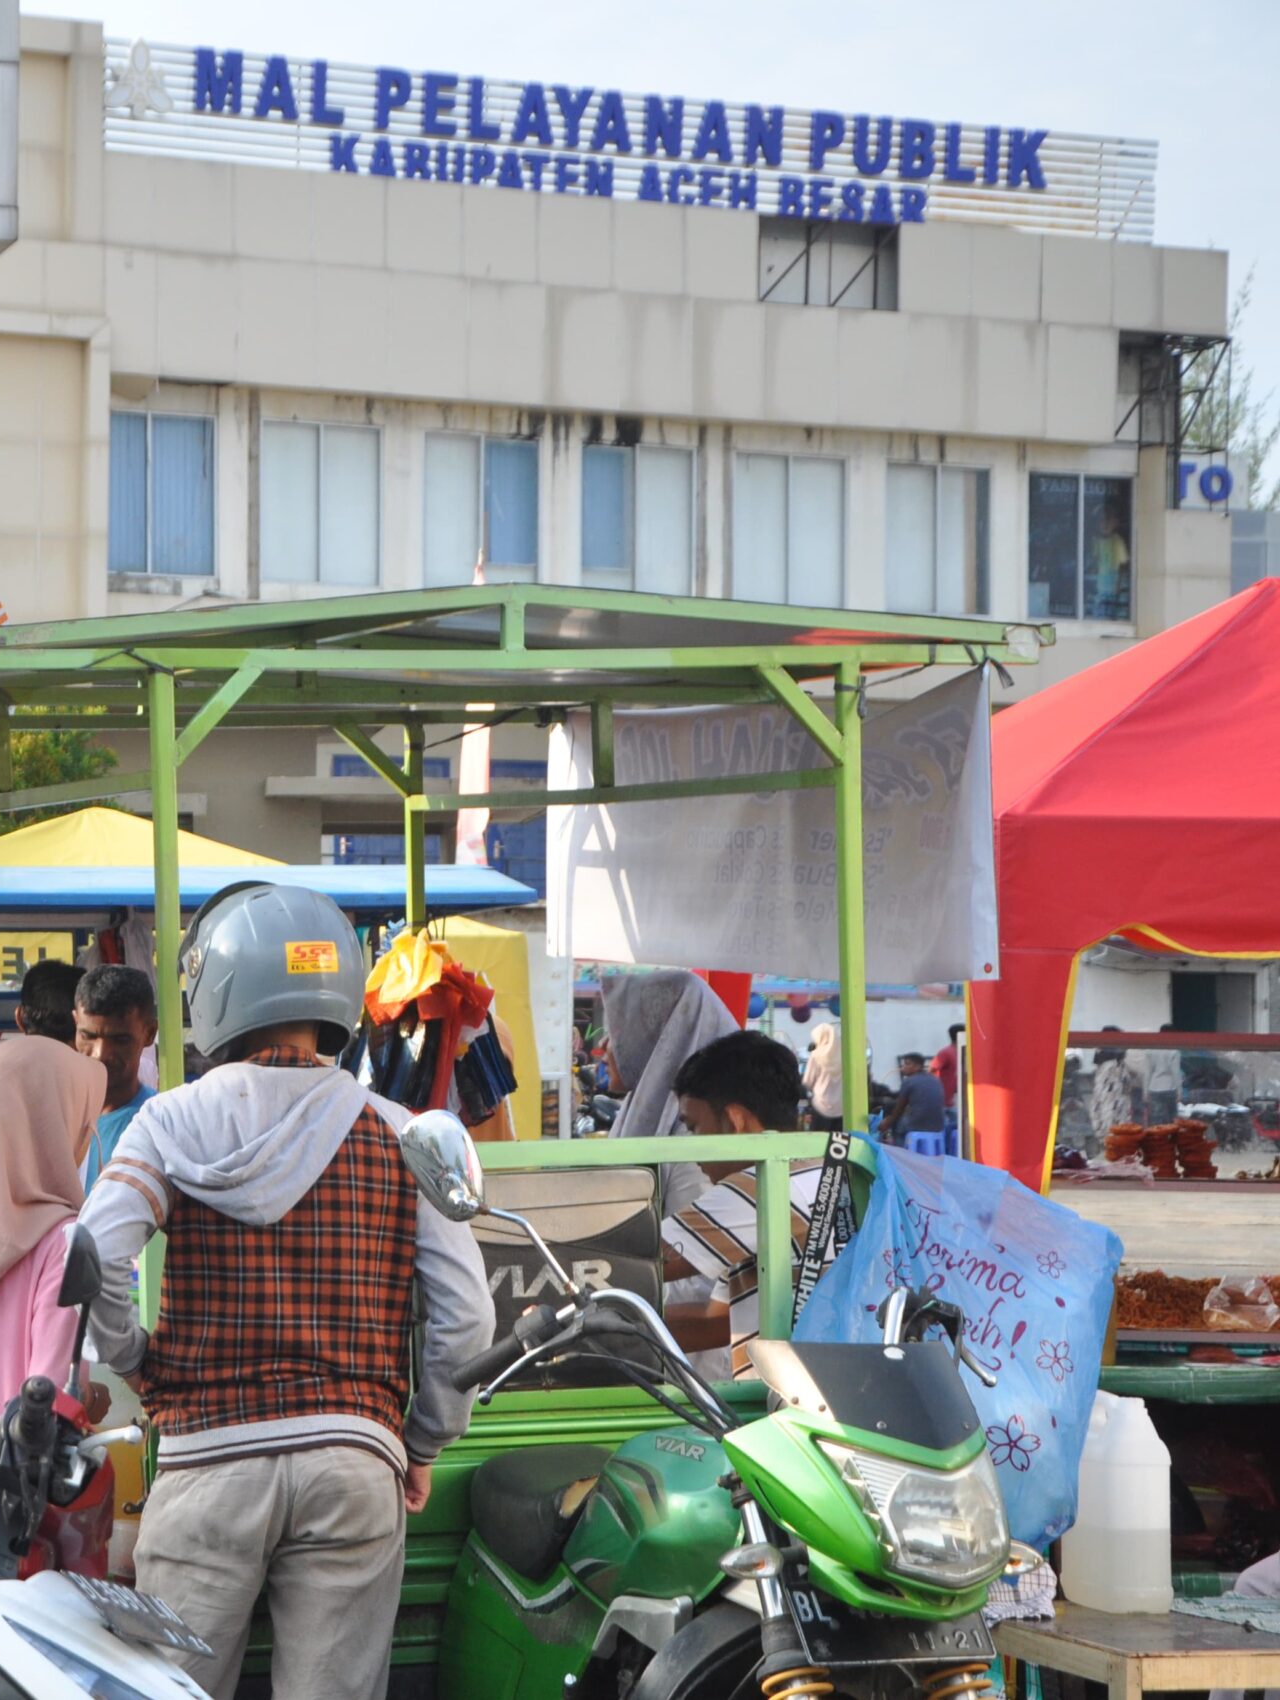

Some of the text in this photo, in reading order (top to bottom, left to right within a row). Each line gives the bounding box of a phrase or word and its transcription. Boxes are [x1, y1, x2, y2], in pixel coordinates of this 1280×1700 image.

[194, 46, 1050, 190] MAL PELAYANAN PUBLIK
[330, 133, 929, 224] KABUPATEN ACEH BESAR
[810, 1213, 824, 1238] WILL
[823, 1166, 834, 1184] lbs
[904, 1199, 1026, 1298] Terima
[654, 1436, 707, 1462] VIAR
[792, 1590, 833, 1625] BL
